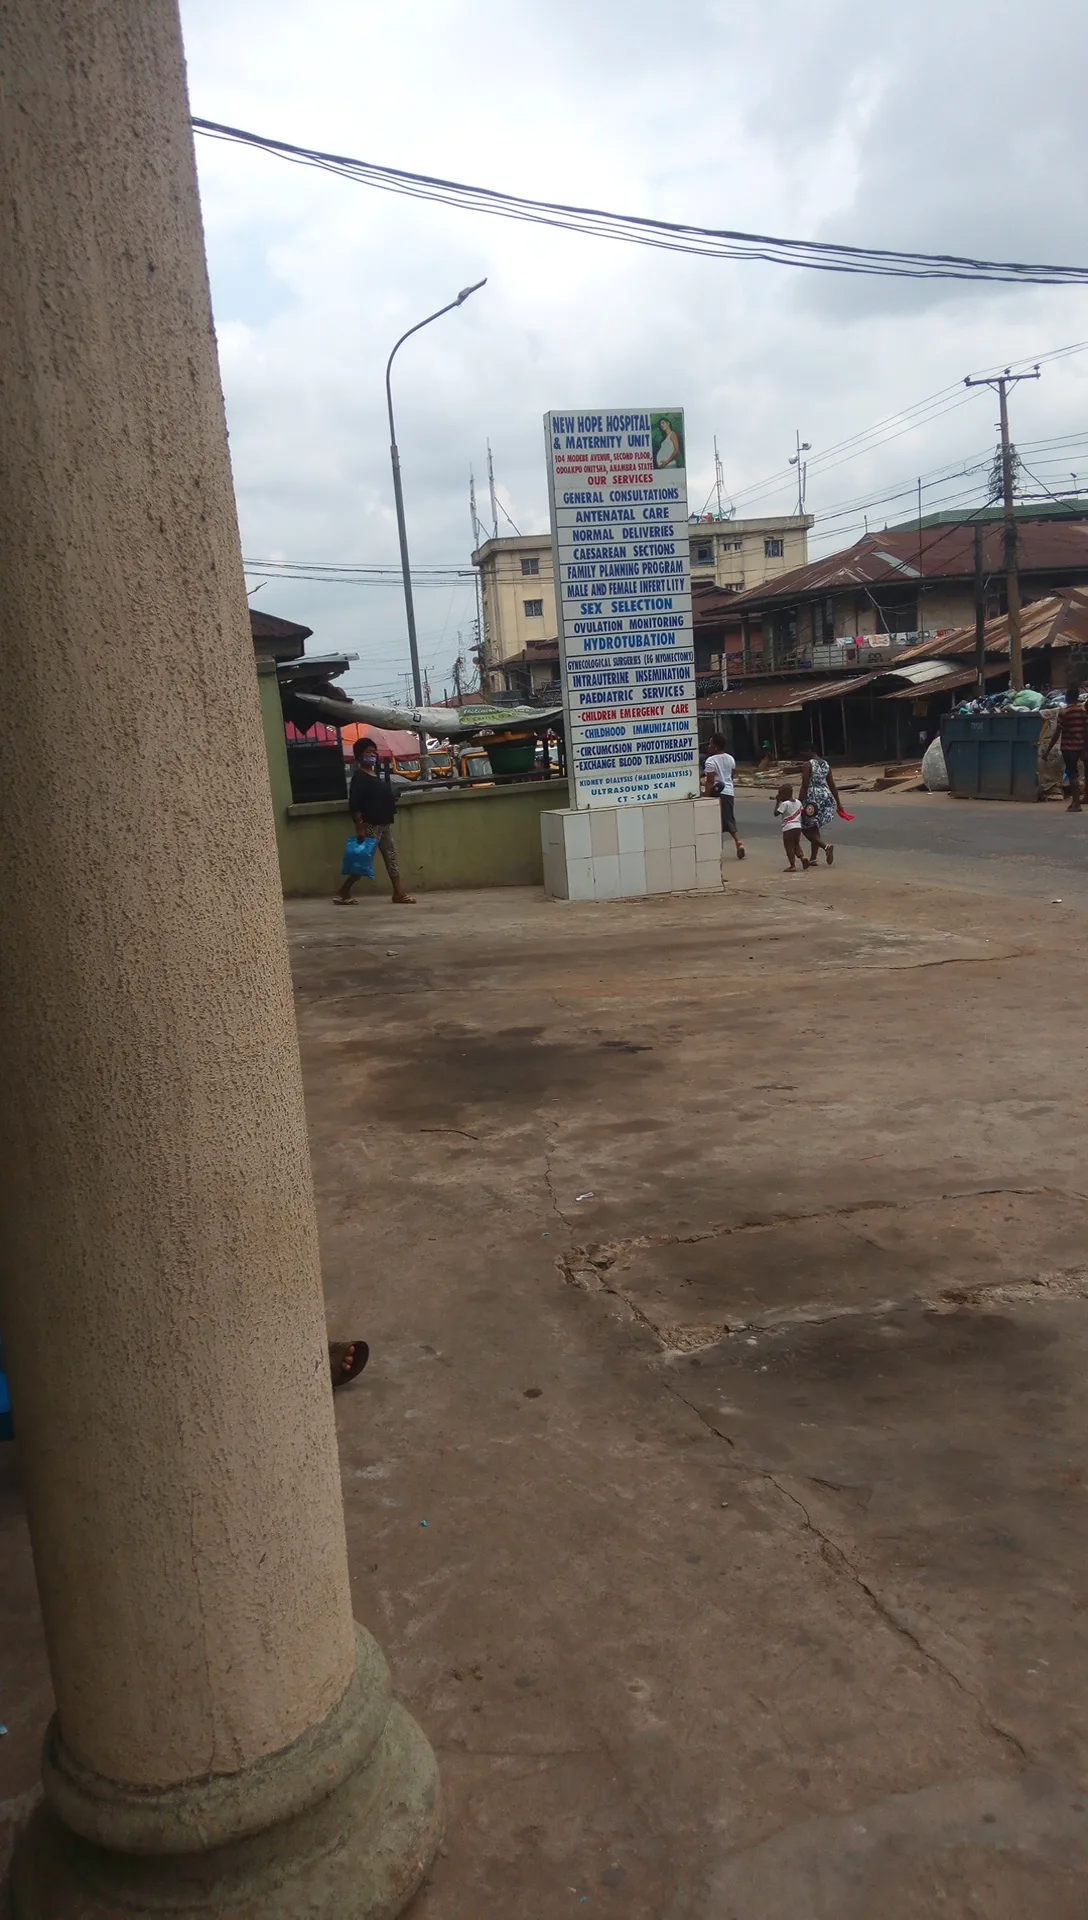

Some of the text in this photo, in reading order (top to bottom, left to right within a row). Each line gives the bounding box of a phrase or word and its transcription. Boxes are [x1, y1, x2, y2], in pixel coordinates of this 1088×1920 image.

[553, 414, 651, 434] NEW HOPE HOSPITAL
[553, 434, 650, 450] & MATERNITY UNIT
[555, 455, 565, 463] 104
[613, 452, 633, 461] SECOND
[610, 463, 636, 472] ANAMBRA
[588, 474, 653, 486] OUR SERVICES
[563, 488, 679, 504] GENERAL CONSULTATIONS
[575, 507, 670, 523] ANTENATAL CARE
[573, 525, 674, 542] NORMAL DELIVERIES
[573, 543, 675, 560] CAESAREAN SECTIONS
[567, 560, 683, 580] FAMILY PLANNING PROGRAM
[567, 584, 590, 598] MALE
[591, 582, 607, 595] AND
[609, 580, 638, 594] FEMALE
[580, 598, 673, 615] SEX SELECTION
[574, 615, 684, 634] OVULATION MONITORING
[583, 632, 676, 651] HYDROTUBATION
[568, 658, 611, 670] GYNECOLOGICAL
[613, 654, 641, 666] SURGERIES
[644, 653, 653, 665] (EG
[573, 667, 691, 688] INTRAUTERINE INSEMINATION
[579, 685, 685, 704] PAEDIATRIC SERVICES
[619, 706, 665, 718] EMERGENCY
[671, 703, 689, 714] CARE
[633, 721, 690, 735] IMMUNIZATION
[636, 737, 693, 753] PHOTOTHERAPY
[619, 754, 643, 767] BLOOD
[645, 751, 694, 765] TRANSFUSION
[579, 769, 692, 787] KIDNEY DIALYSIS (HAEMODIALYSIS)
[591, 781, 676, 796] ULTRASOUND SCAN
[617, 795, 629, 803] CT
[636, 792, 658, 801] SCAN
